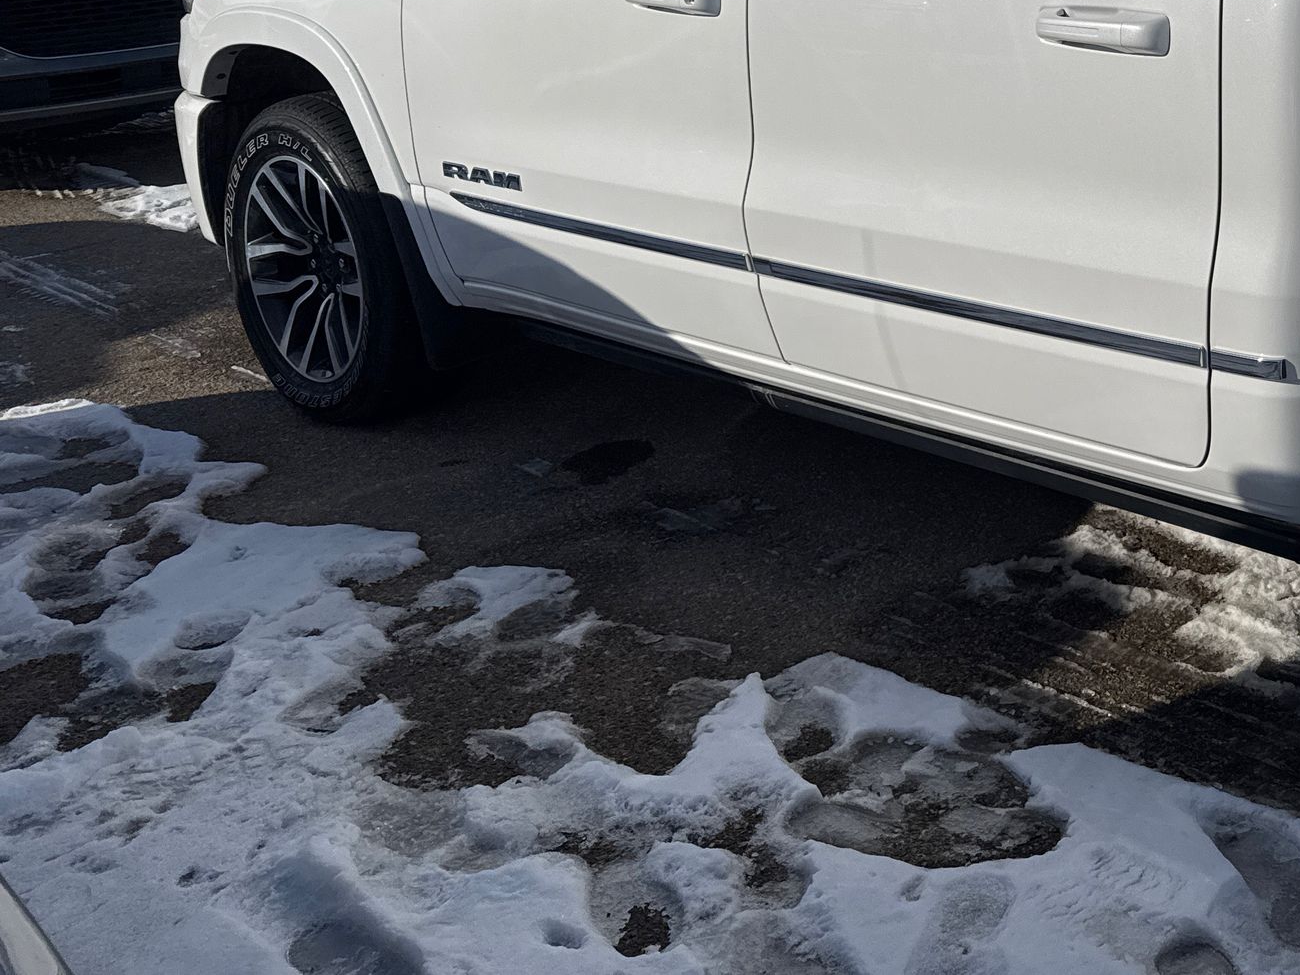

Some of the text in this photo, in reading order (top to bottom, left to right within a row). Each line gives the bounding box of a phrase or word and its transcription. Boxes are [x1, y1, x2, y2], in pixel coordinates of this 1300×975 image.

[224, 133, 312, 238] DUELER H/L
[442, 161, 523, 192] RAM
